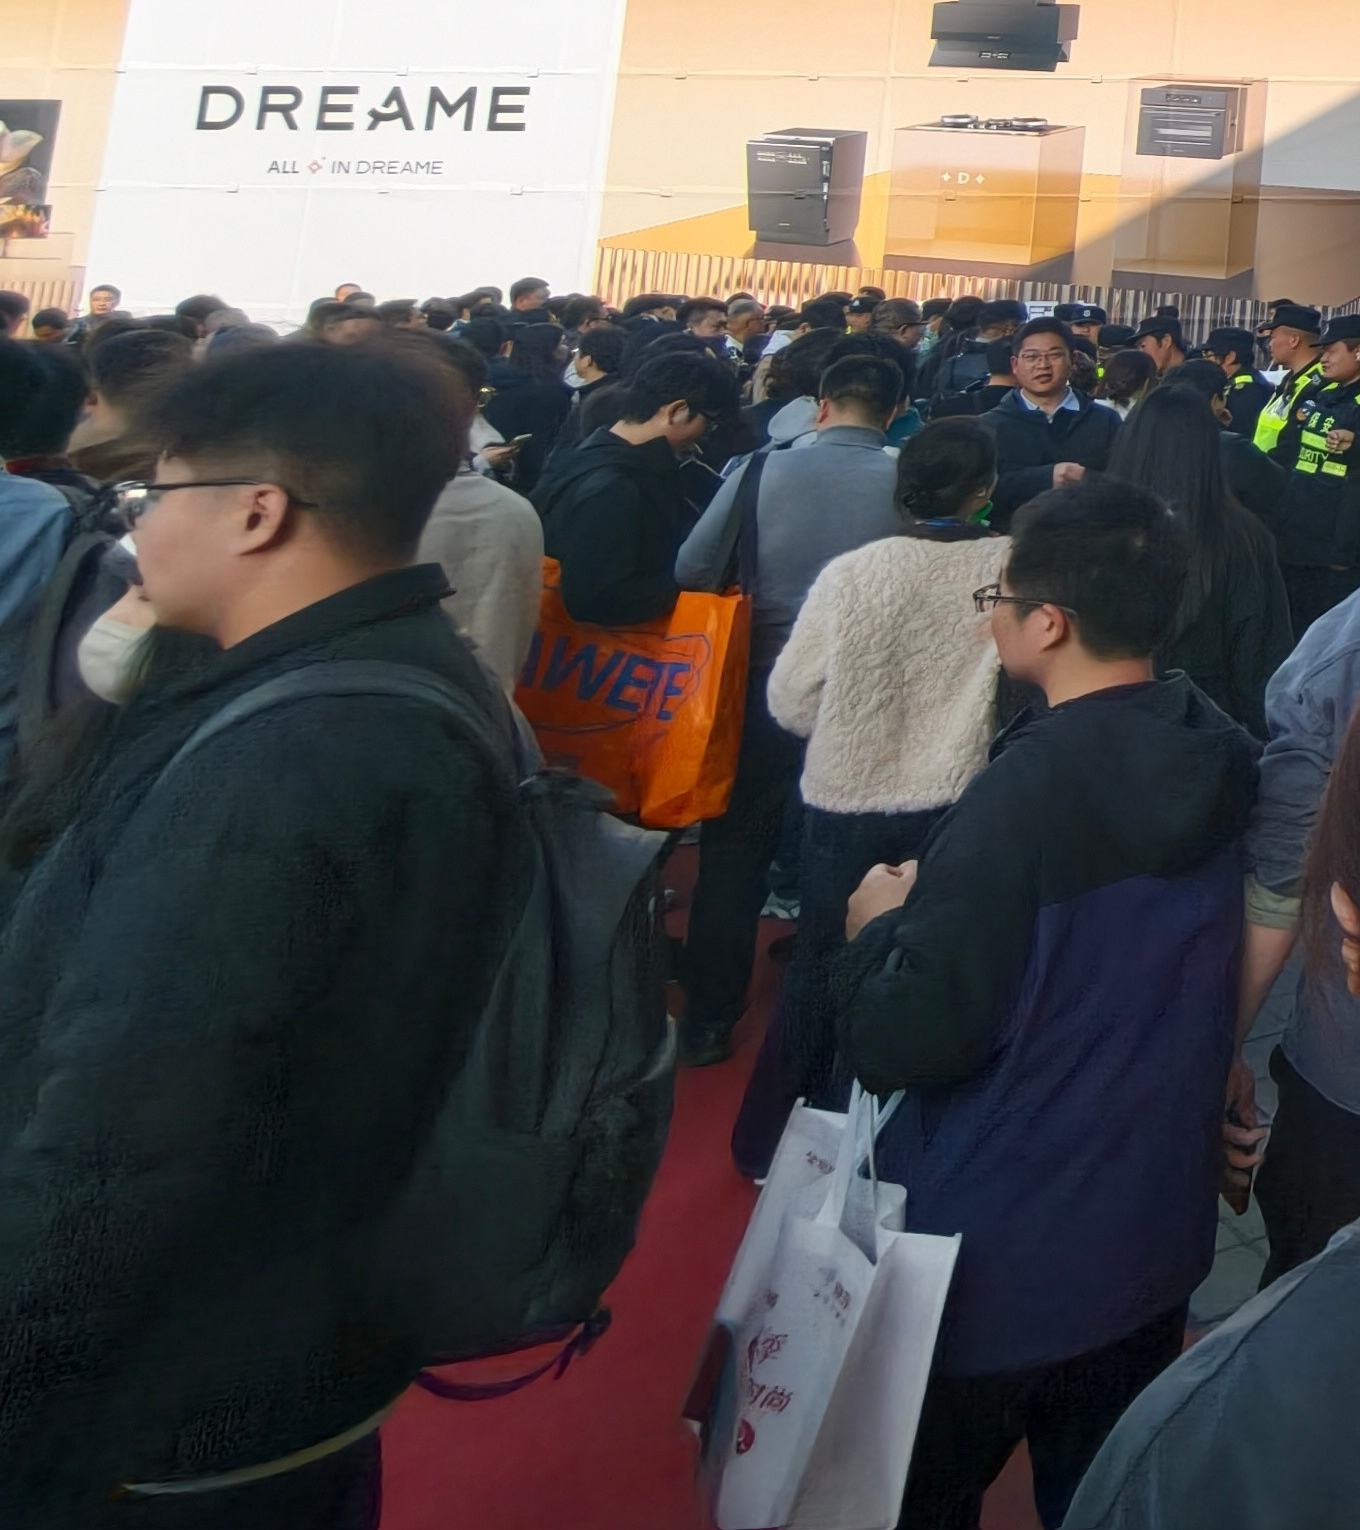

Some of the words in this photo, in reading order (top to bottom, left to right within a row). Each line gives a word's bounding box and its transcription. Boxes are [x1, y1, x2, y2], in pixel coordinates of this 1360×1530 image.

[196, 85, 531, 132] DREAME
[267, 160, 300, 174] ALL
[331, 160, 351, 175] IN
[356, 161, 444, 175] DREAME
